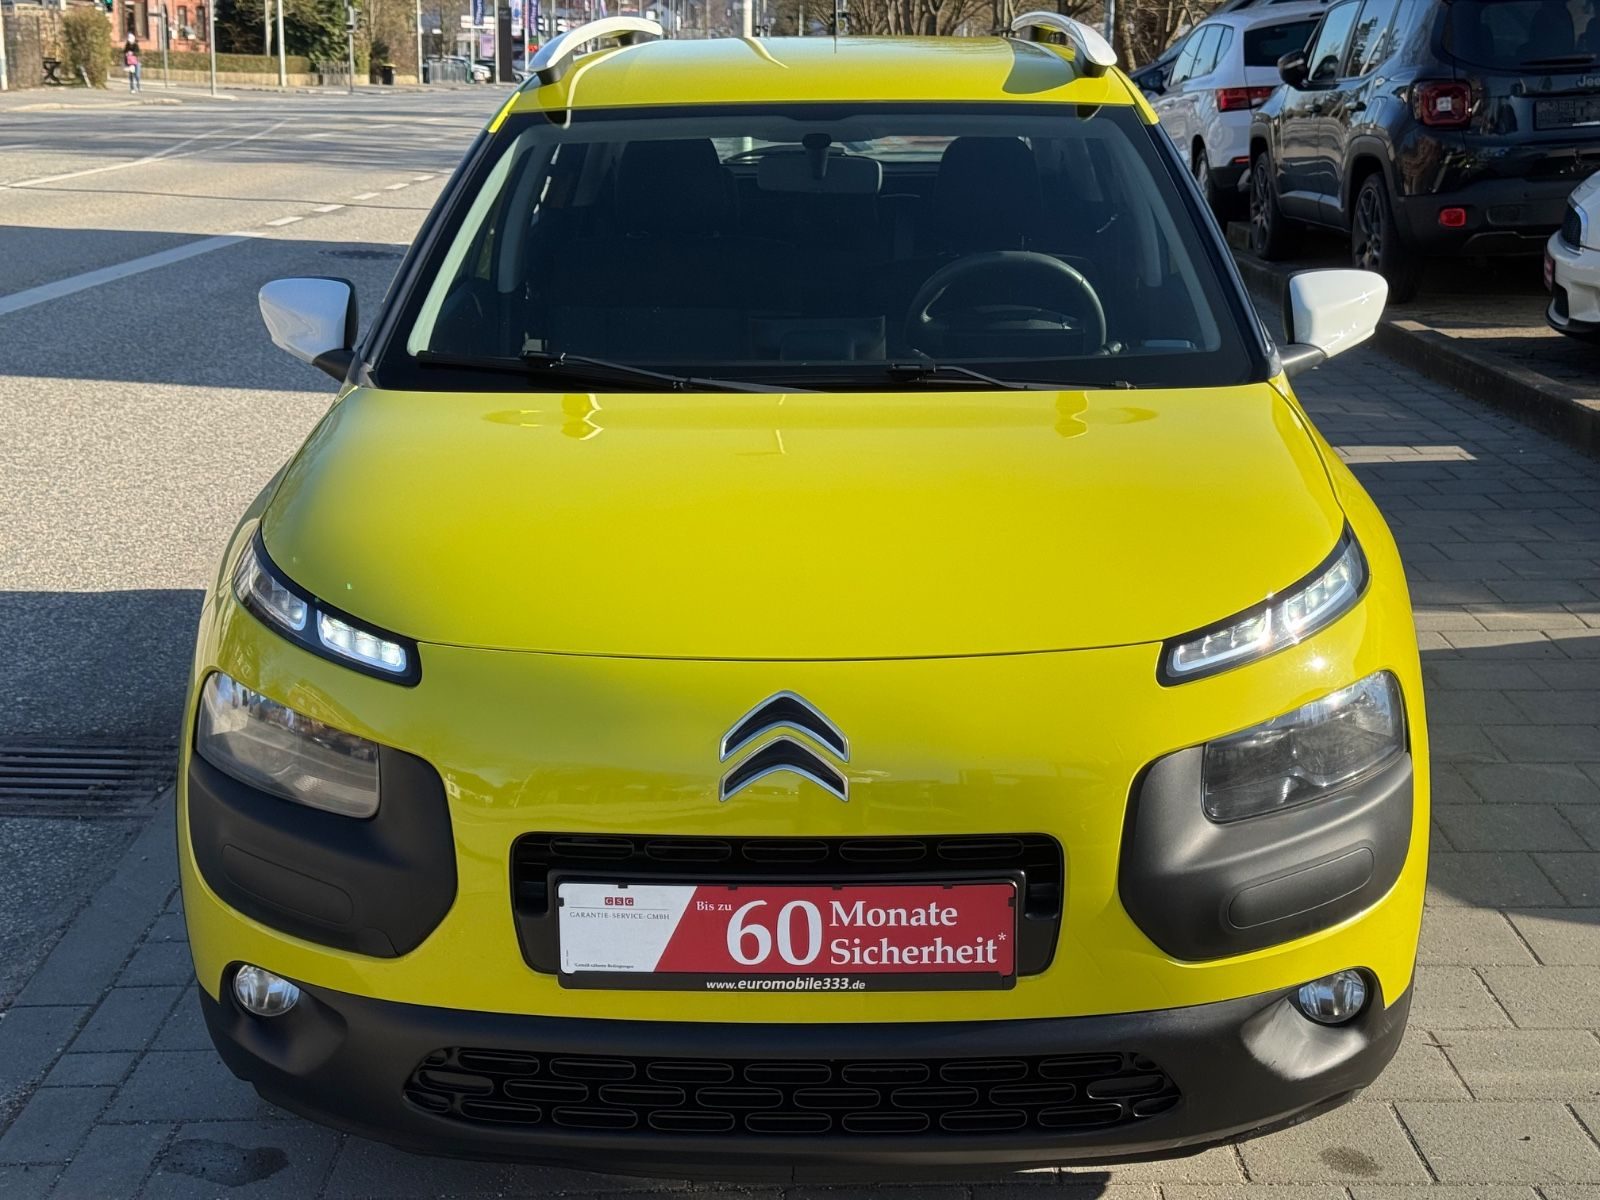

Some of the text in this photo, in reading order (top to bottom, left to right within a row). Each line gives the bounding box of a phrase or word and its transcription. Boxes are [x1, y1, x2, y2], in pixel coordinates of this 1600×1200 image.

[604, 897, 634, 906] GSG
[696, 901, 733, 911] Bis zu
[829, 900, 958, 927] Monate
[726, 899, 823, 966] 60
[706, 977, 866, 990] www.euromobile333.de
